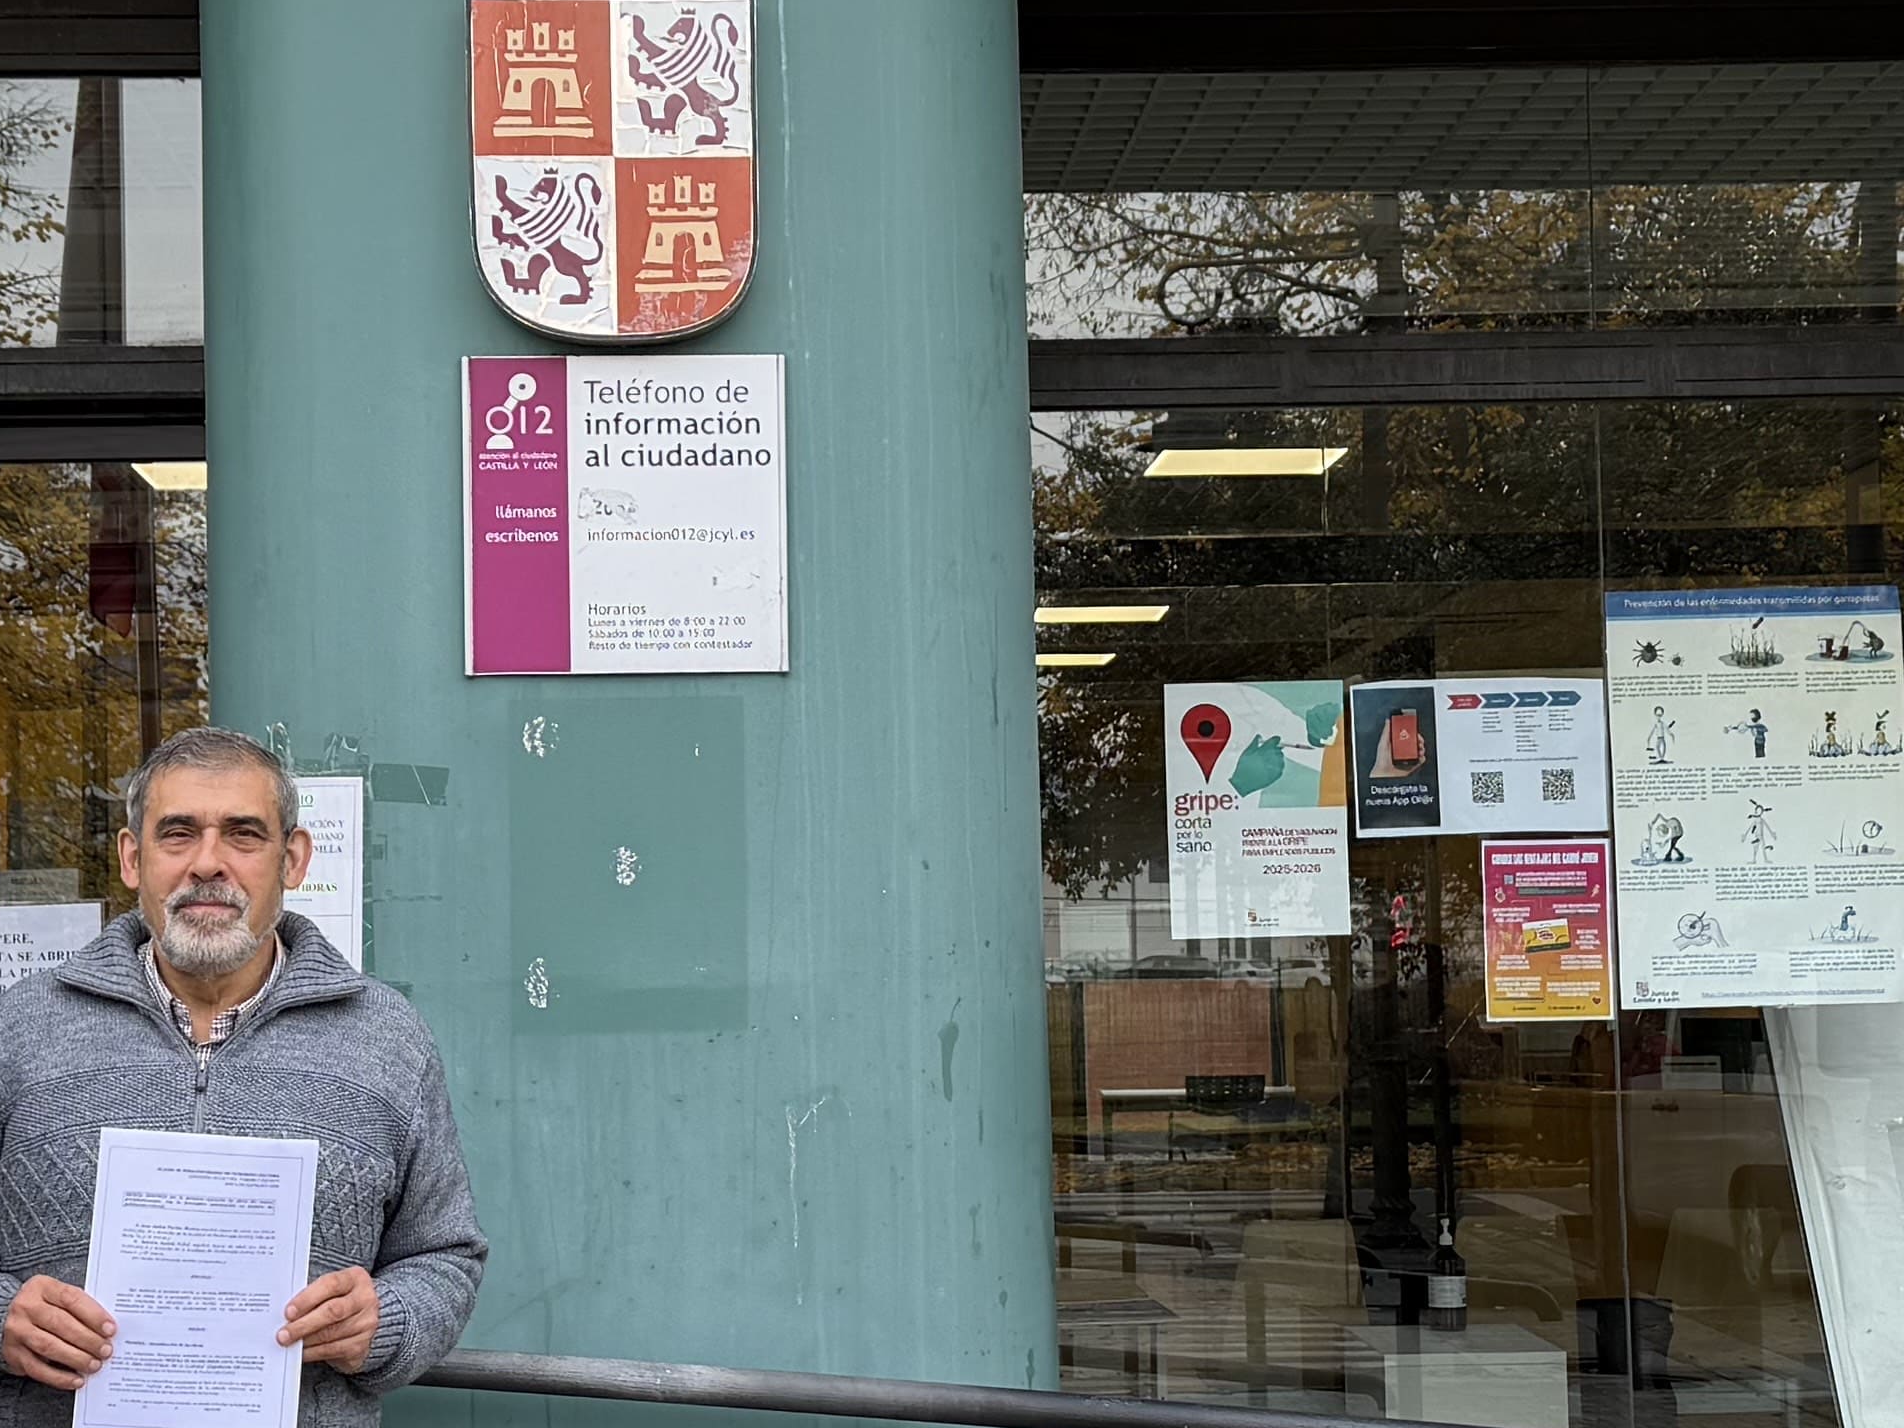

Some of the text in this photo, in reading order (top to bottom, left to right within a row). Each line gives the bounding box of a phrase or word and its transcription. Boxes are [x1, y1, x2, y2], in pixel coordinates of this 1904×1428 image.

[584, 378, 749, 404] Teléfono de
[485, 406, 554, 434] 012
[585, 411, 761, 435] información
[585, 442, 771, 467] al ciudadano
[479, 459, 558, 470] CASTILLA Y LEÓN
[496, 505, 557, 518] llámanos
[485, 528, 559, 543] escríbenos
[588, 528, 756, 543] informacion012@jcyl.es
[588, 604, 647, 616] Horarios
[1624, 599, 1672, 609] Prevención
[588, 617, 617, 627] Lunes
[629, 617, 665, 627] viernes
[669, 617, 681, 626] de
[632, 628, 645, 638] de
[1174, 790, 1239, 816] gripe:
[1175, 817, 1212, 829] corta
[1176, 829, 1203, 840] por lo
[17, 951, 34, 962] SE
